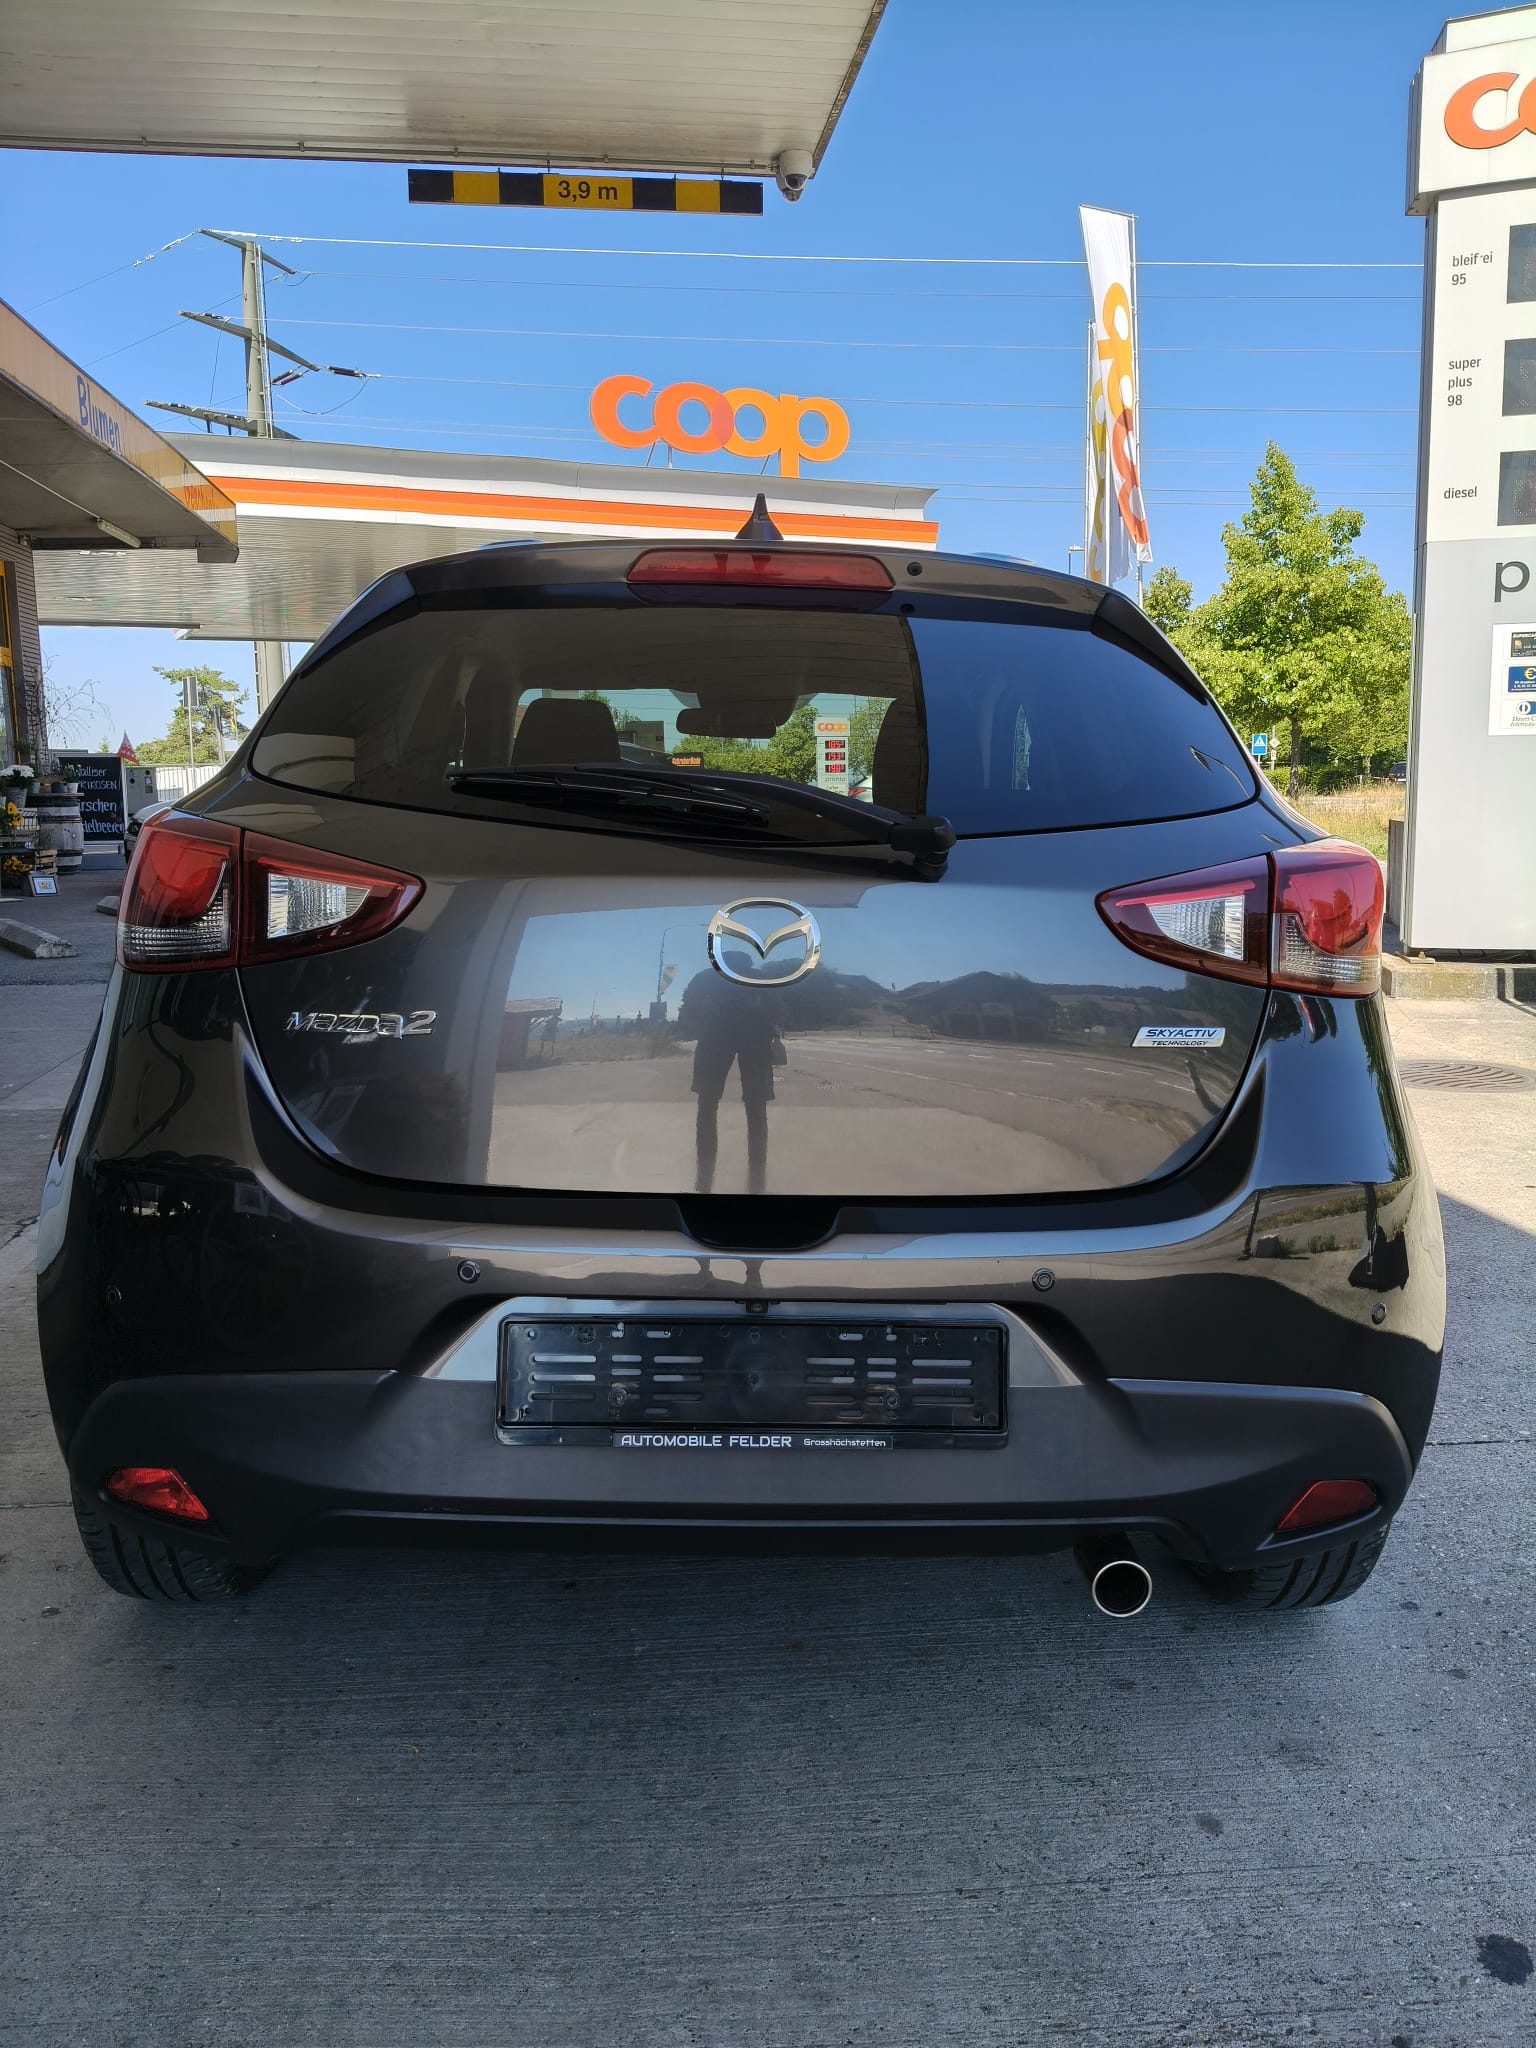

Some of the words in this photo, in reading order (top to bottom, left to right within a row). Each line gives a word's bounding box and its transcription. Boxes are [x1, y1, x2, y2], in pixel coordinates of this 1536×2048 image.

[558, 180, 591, 202] 3,9
[598, 186, 618, 201] m
[1452, 251, 1493, 267] bleifei
[1451, 273, 1467, 286] 95
[1448, 357, 1481, 370] super
[1448, 377, 1472, 391] plus
[1447, 394, 1463, 407] 98
[76, 375, 122, 455] Blumen
[589, 373, 850, 479] coop
[1443, 486, 1478, 499] diesel
[817, 722, 848, 734] coop
[1145, 1029, 1217, 1037] SKYACTIV
[621, 1435, 722, 1447] AUTOMOBILE
[729, 1436, 792, 1447] FELDER
